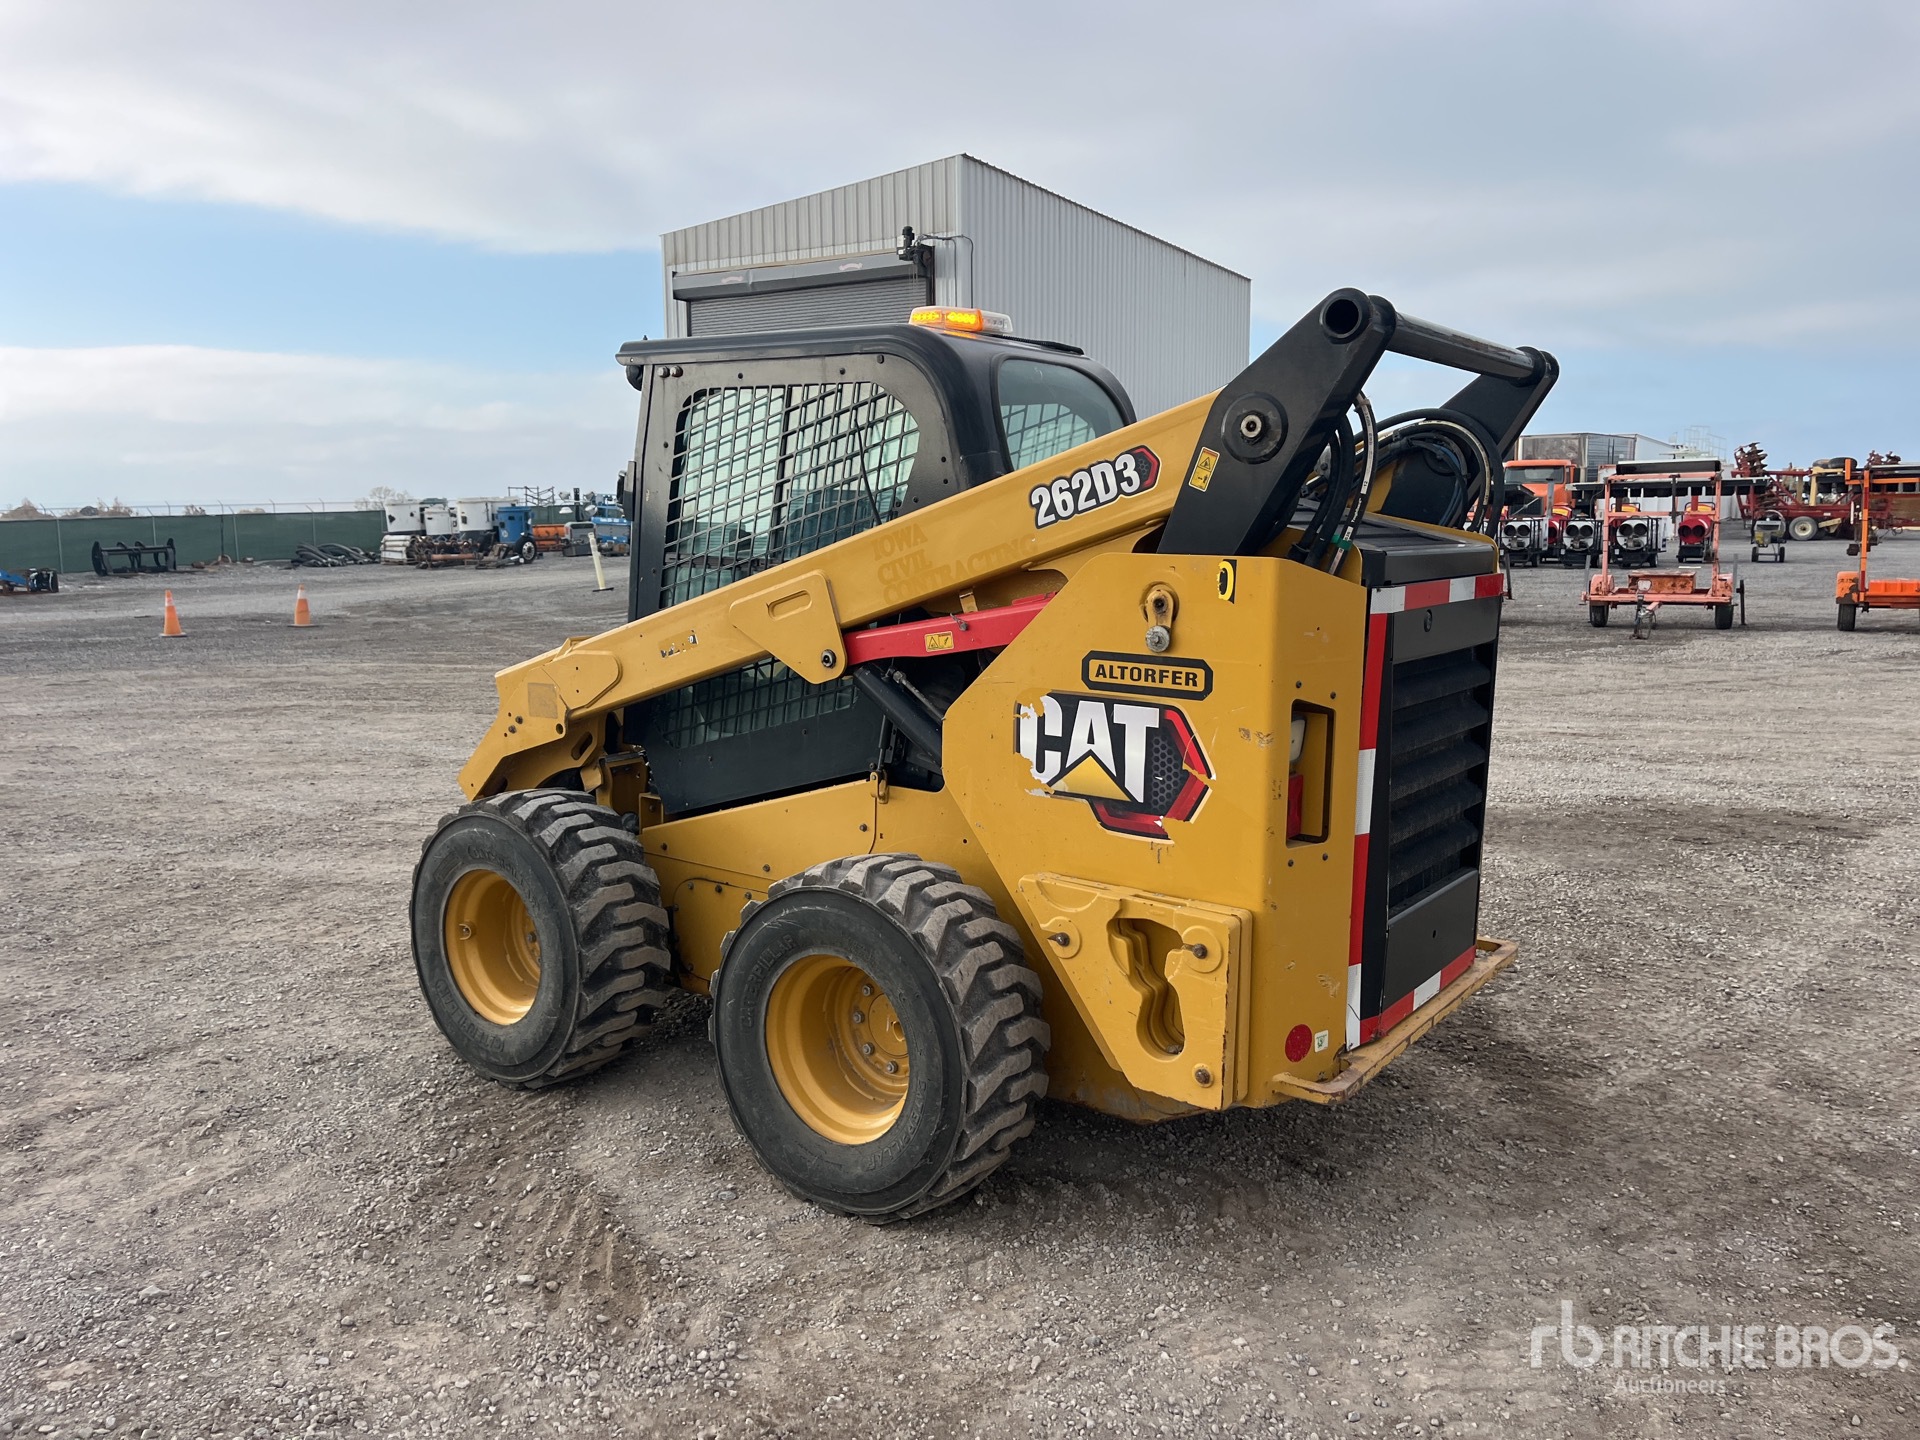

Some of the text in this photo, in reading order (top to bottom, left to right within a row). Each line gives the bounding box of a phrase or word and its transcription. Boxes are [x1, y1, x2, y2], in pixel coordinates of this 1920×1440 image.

[1030, 453, 1141, 527] 262D3
[871, 523, 928, 562] IOWA
[877, 550, 933, 585] CIVIL
[883, 532, 1039, 605] CONTRACTING
[1094, 663, 1199, 688] ALTORFER
[1019, 694, 1160, 804] CAT
